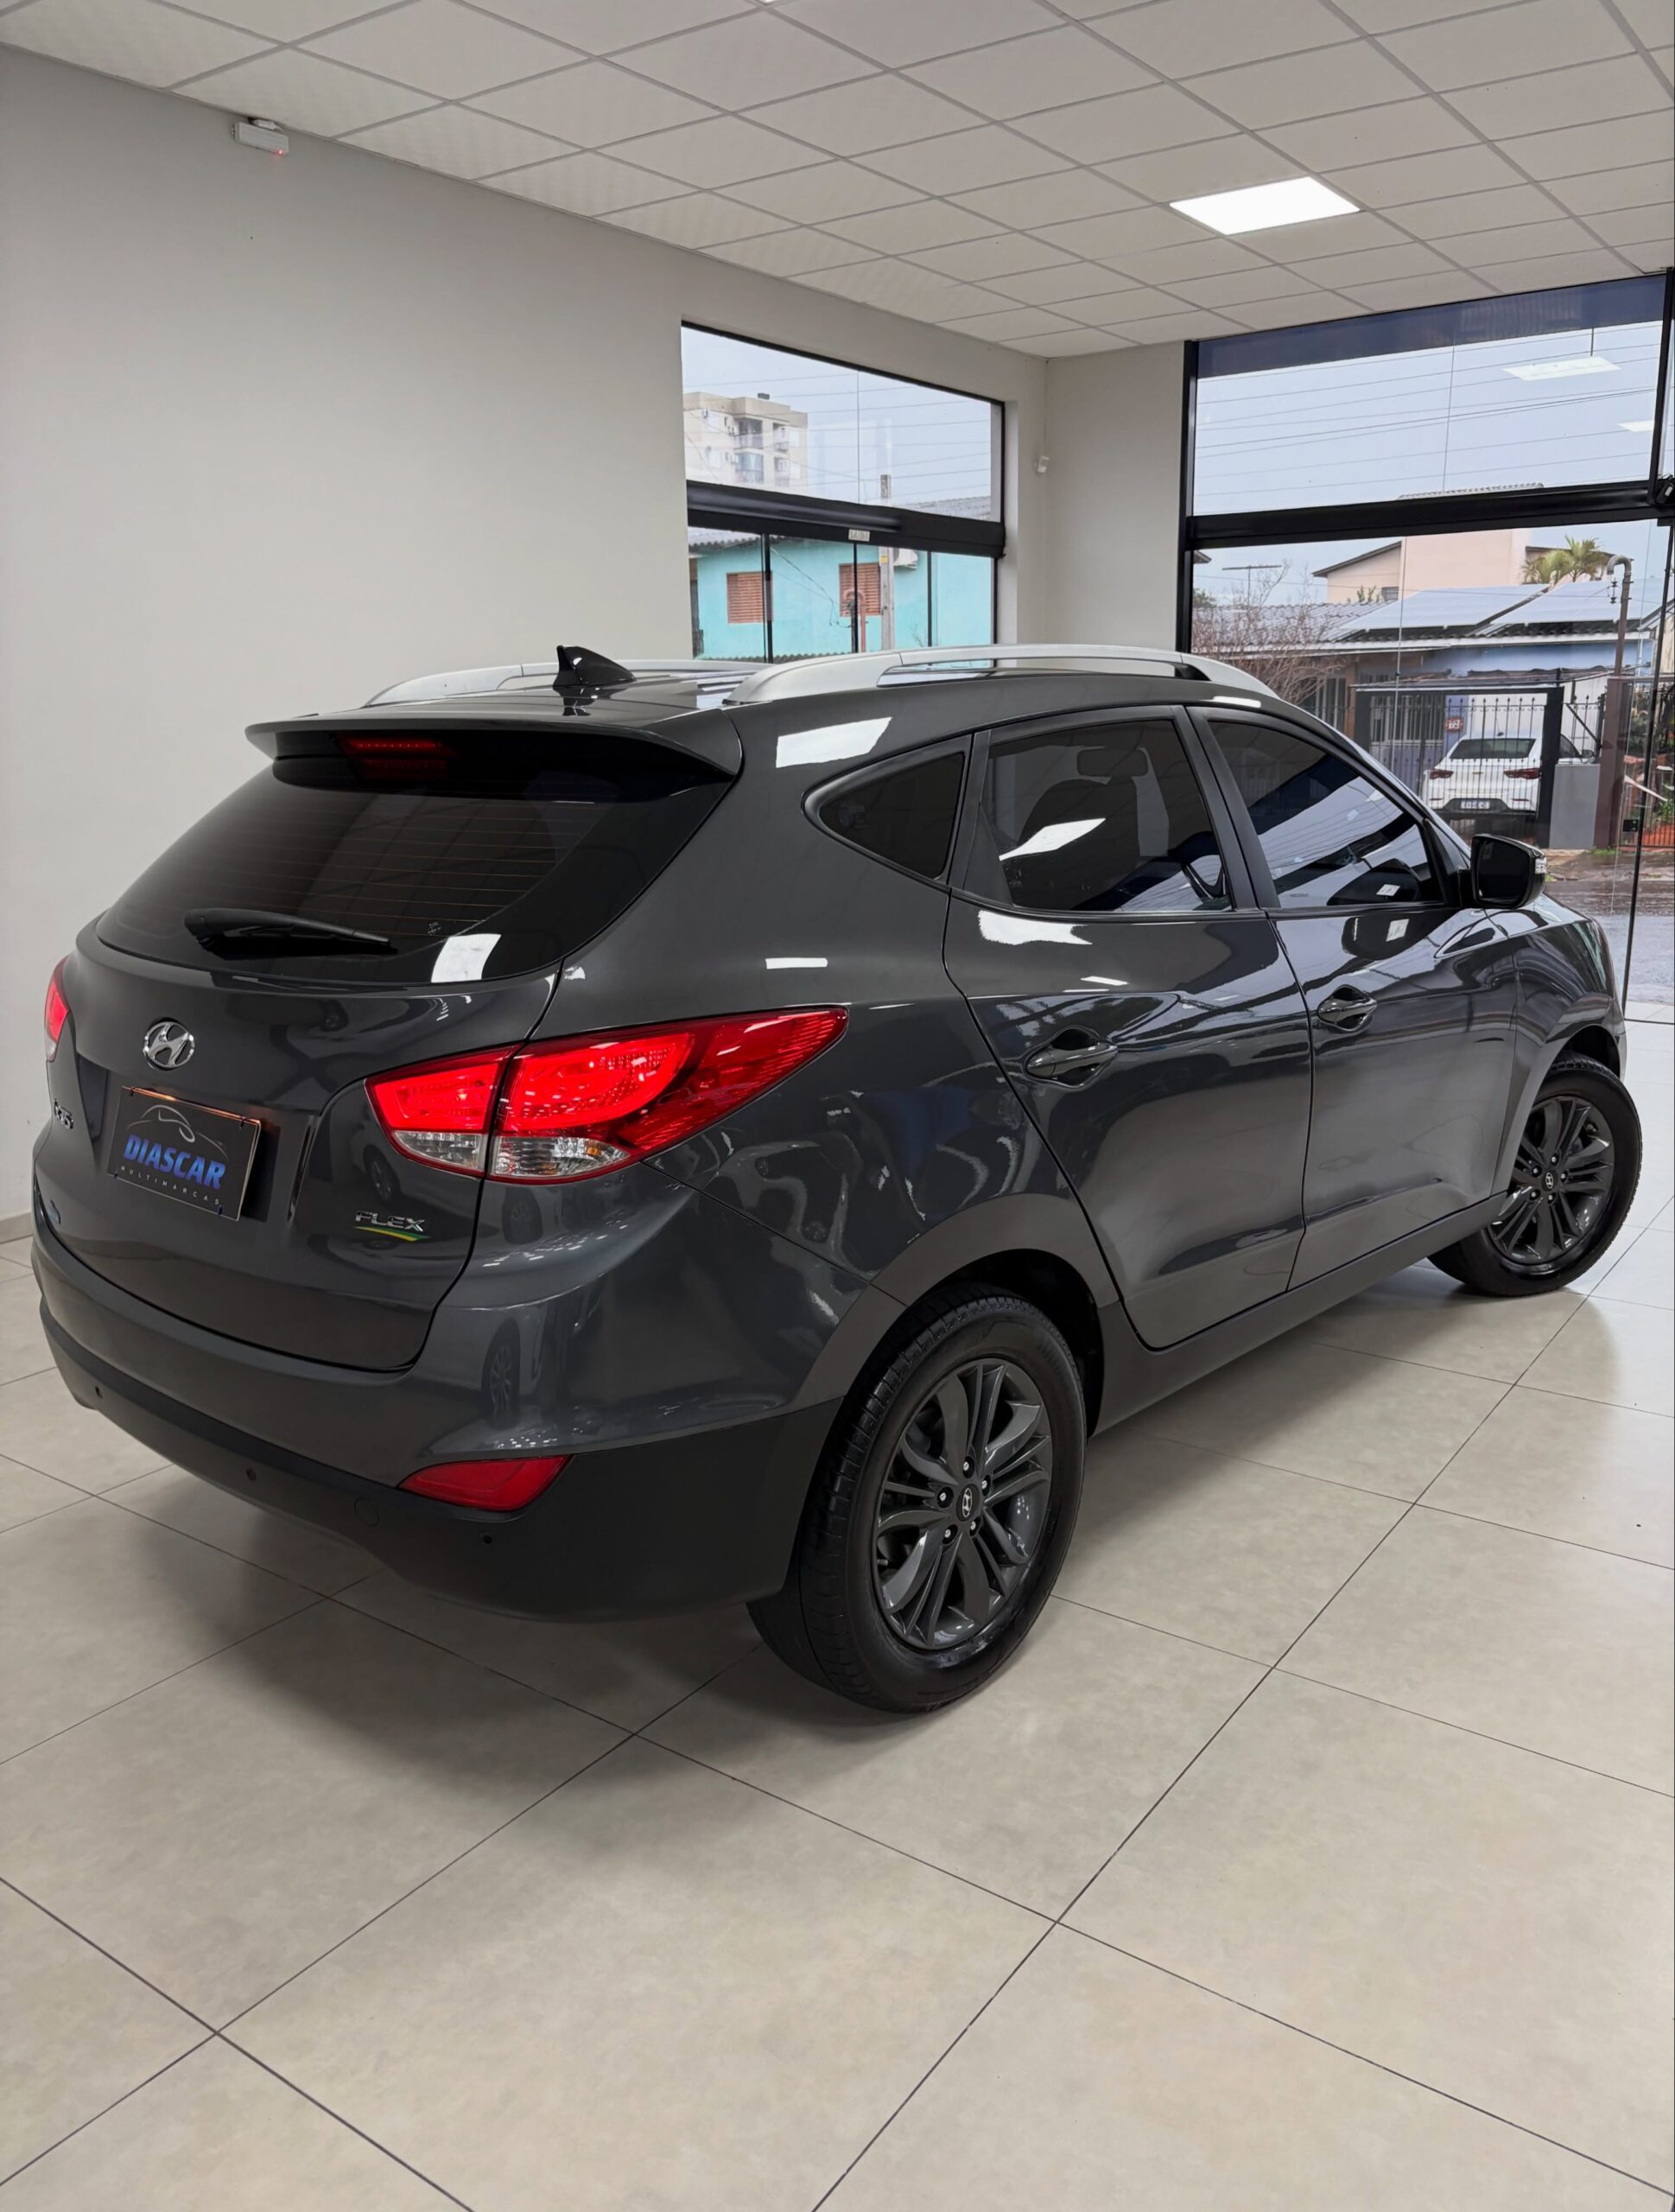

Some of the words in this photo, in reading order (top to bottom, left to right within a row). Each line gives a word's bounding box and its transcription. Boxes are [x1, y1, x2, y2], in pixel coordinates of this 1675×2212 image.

[124, 1134, 226, 1190] DIASCAR
[121, 1165, 219, 1205] MULTIMARCAS
[355, 1211, 426, 1232] FLEX
